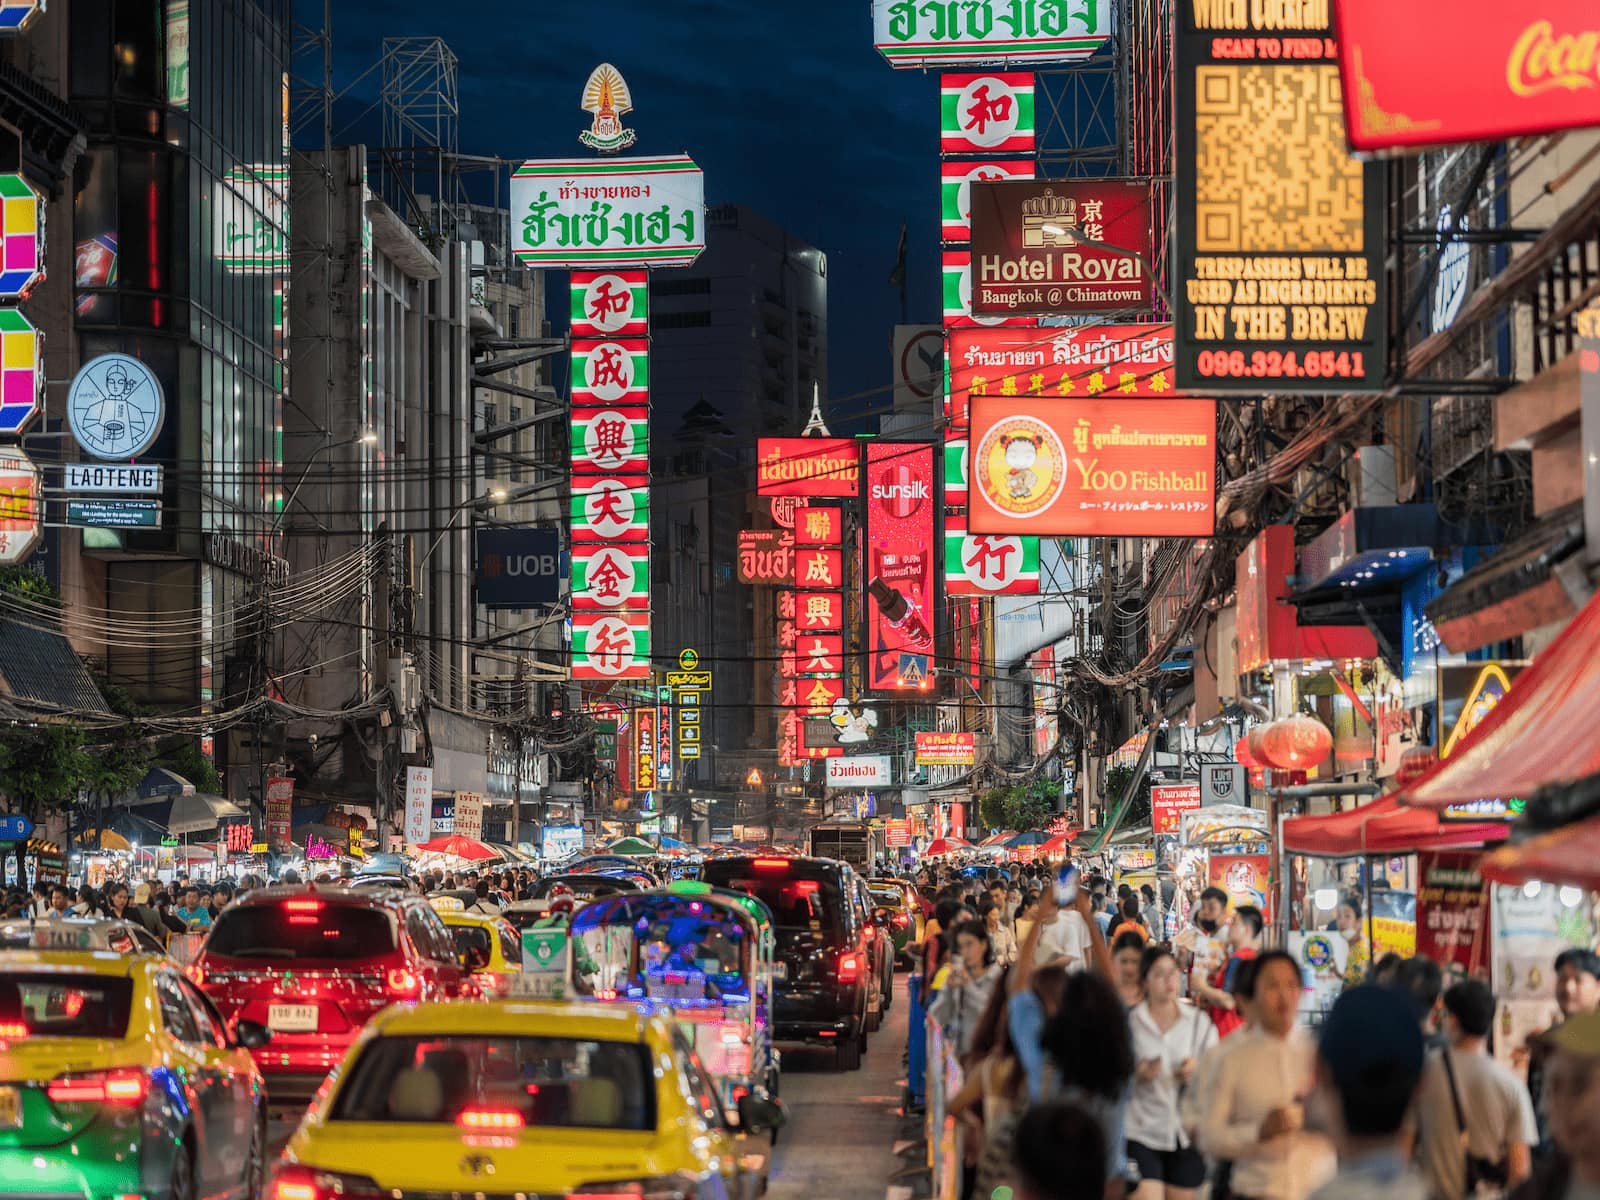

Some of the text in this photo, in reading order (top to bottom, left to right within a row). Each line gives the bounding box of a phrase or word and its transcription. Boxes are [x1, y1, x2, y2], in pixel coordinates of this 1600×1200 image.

[1212, 38, 1255, 58] SCAN
[1256, 38, 1281, 58] TO
[1282, 38, 1323, 58] FIND
[559, 180, 651, 200] ห้างขายทอง
[522, 191, 695, 246] ฮั่วเซ่งเฮง
[981, 253, 1142, 281] Hotel Royal
[1195, 257, 1367, 279] TRESPASSERS WILL BE
[981, 287, 1142, 308] Bangkok @ Chinatown
[1186, 279, 1376, 304] USED AS INGREDIENTS
[1194, 306, 1368, 340] IN THE BREW
[1197, 350, 1366, 377] 096.324.6541
[71, 468, 153, 487] LAOTENG
[1130, 470, 1208, 491] Fishball
[872, 480, 929, 499] sunsilk
[506, 556, 556, 577] UOB
[17, 819, 25, 834] 9
